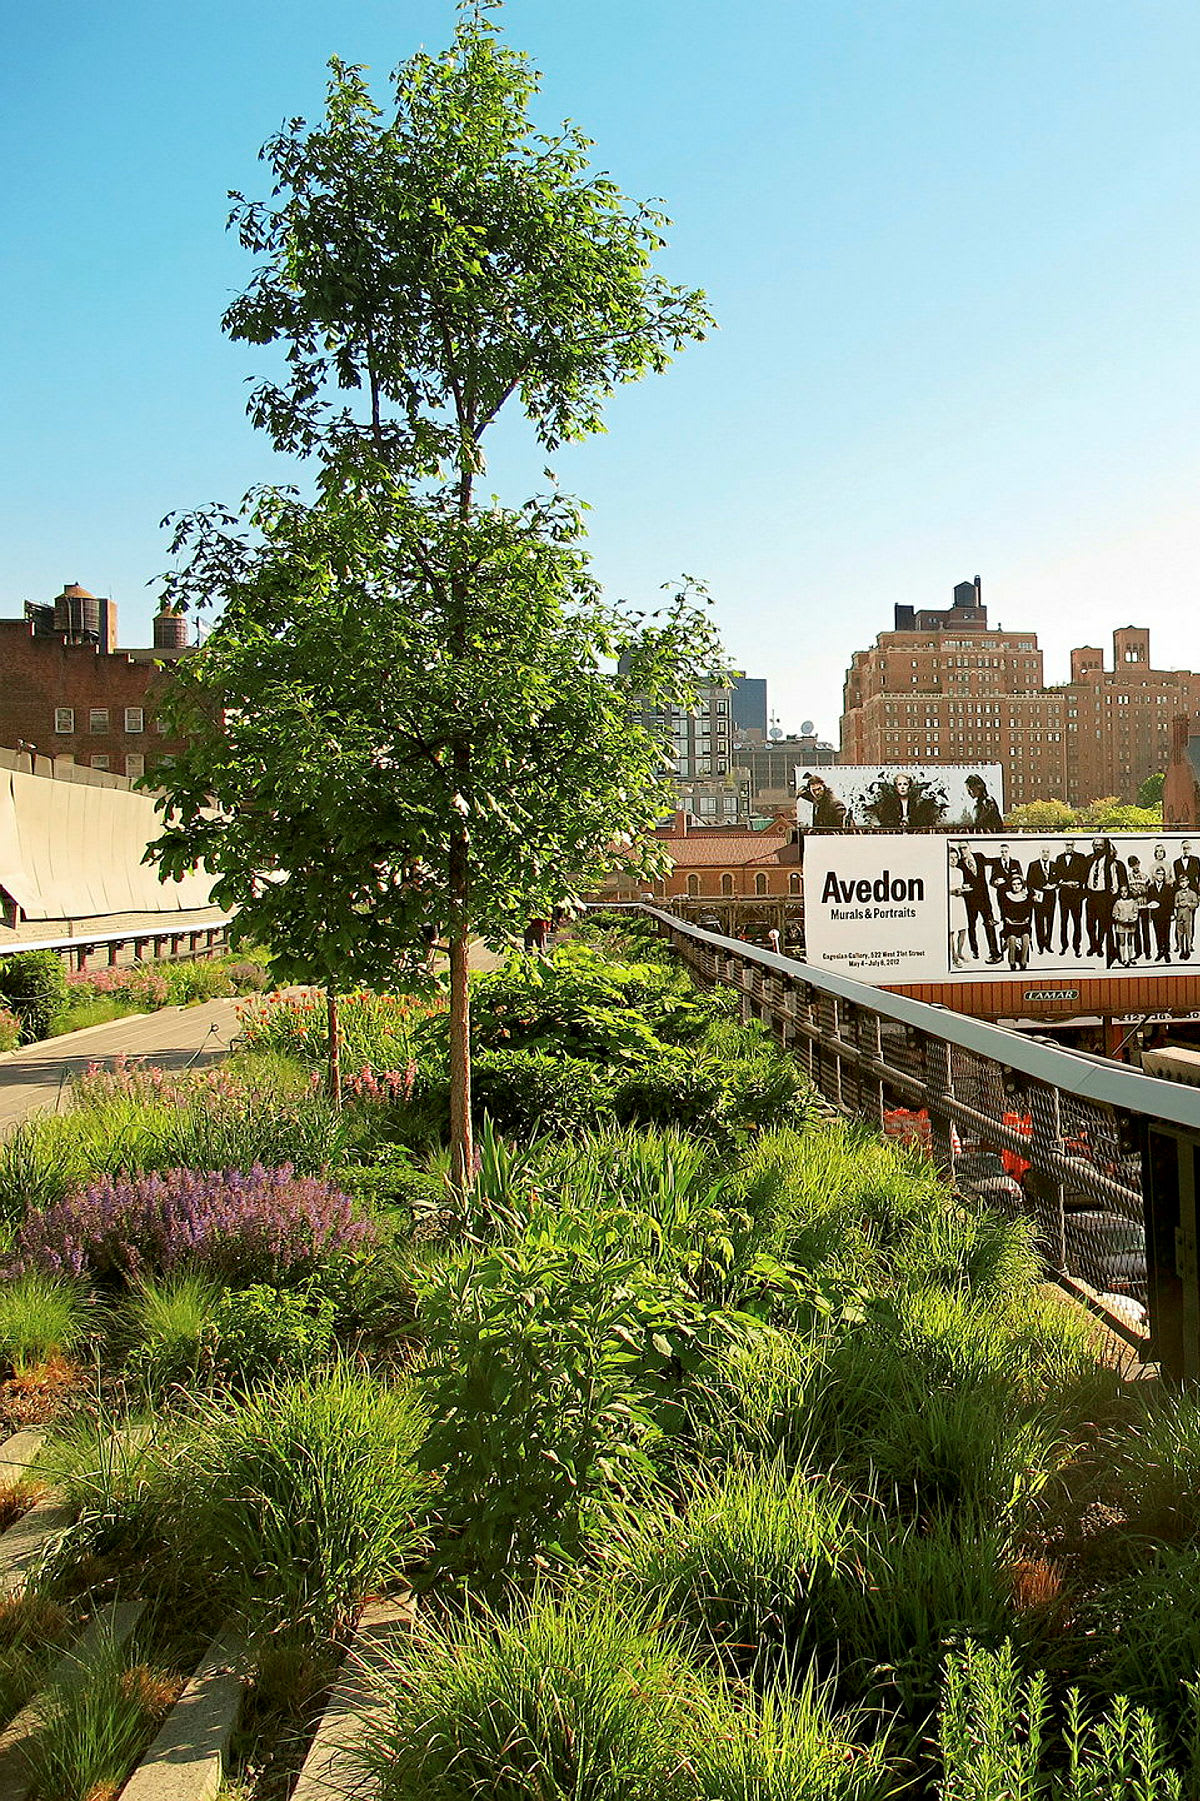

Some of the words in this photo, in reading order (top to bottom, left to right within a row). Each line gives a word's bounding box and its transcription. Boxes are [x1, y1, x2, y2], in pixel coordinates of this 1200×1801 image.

[821, 870, 924, 904] Avedon
[831, 909, 863, 920] Murals
[864, 908, 873, 919] &
[874, 907, 916, 919] Portraits
[1028, 991, 1075, 1000] LAMAR
